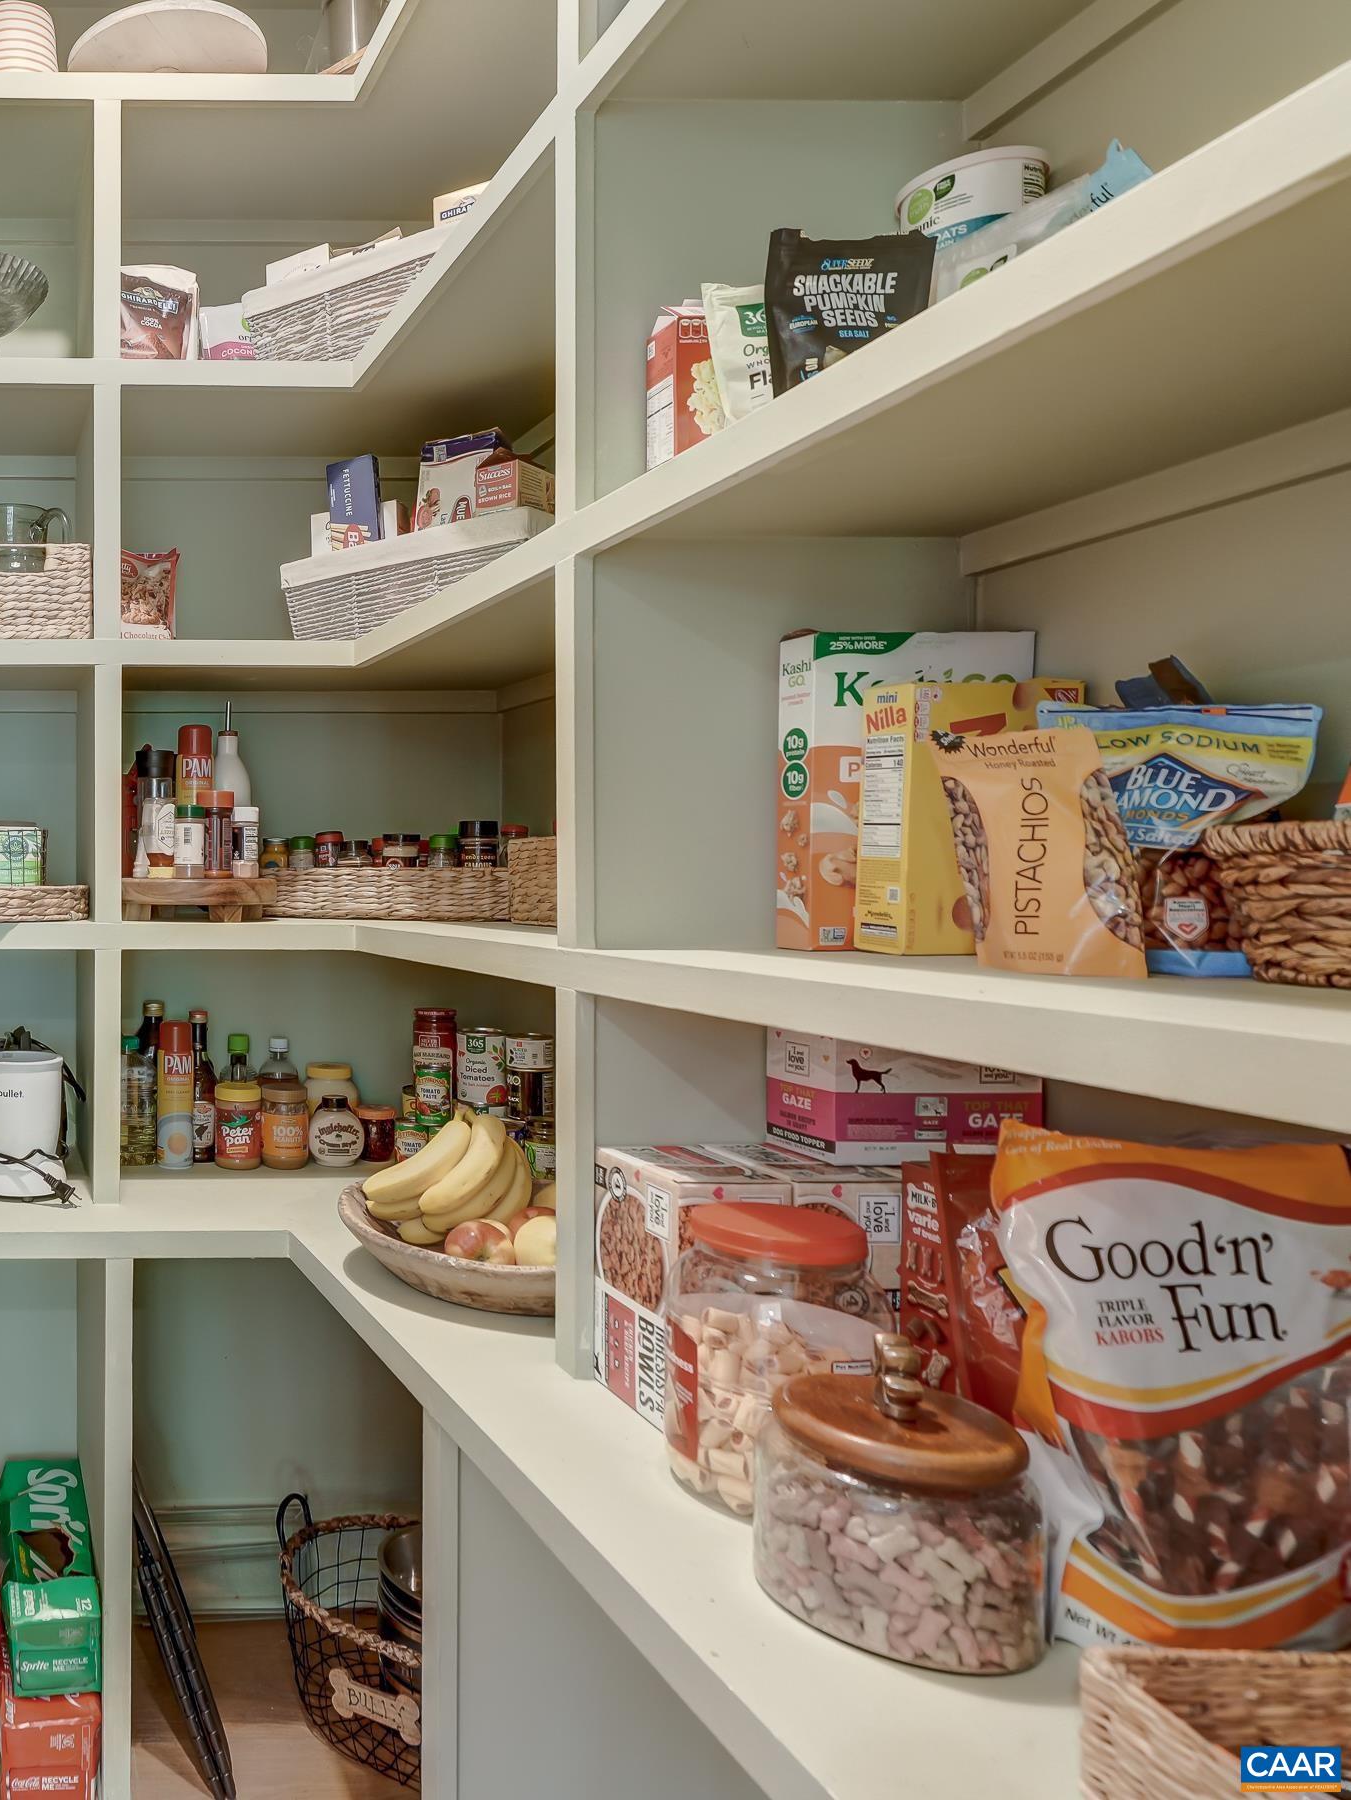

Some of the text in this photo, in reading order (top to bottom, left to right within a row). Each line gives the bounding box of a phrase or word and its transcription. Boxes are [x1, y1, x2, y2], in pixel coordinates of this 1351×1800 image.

[793, 271, 899, 297] SNACKABLE
[803, 293, 887, 313] PUMPKIN
[822, 308, 879, 328] SEEDS
[838, 329, 870, 338] SEA SALT
[478, 467, 512, 482] Success
[829, 640, 854, 651] 25%
[782, 658, 812, 677] Kashi
[877, 691, 898, 704] mini
[865, 706, 908, 735] Nilla
[786, 735, 805, 750] 10g
[966, 736, 1056, 759] Wonderful
[1161, 730, 1261, 755] SODIUM
[181, 758, 212, 778] PAM
[985, 758, 1056, 770] Honey Roasted
[786, 773, 805, 788] 10g
[1126, 764, 1203, 793] BLUE
[1014, 776, 1050, 935] PISTACHIOS
[467, 1038, 484, 1048] 365
[164, 1055, 192, 1074] PAM
[788, 1053, 805, 1065] love
[465, 1065, 488, 1074] Diced
[459, 1073, 495, 1082] Tomatoes
[782, 1095, 812, 1111] GAZE
[220, 1126, 254, 1138] Peter
[272, 1125, 303, 1137] 100%
[772, 1127, 826, 1150] DOG FOOD TOPPER
[873, 1201, 889, 1233] love
[1097, 1298, 1148, 1313] TRIPLE
[1097, 1313, 1155, 1327] FLAVOR
[1159, 1284, 1284, 1353] Fun
[1095, 1327, 1165, 1347] KABOBS
[638, 1314, 655, 1414] BOWLS
[81, 1598, 92, 1611] 12
[1064, 1607, 1092, 1629] Net
[20, 1660, 50, 1673] Sprite
[52, 1657, 89, 1665] RECYCLE
[52, 1665, 65, 1673] ME
[41, 1775, 79, 1784] RECYCLE
[41, 1783, 55, 1791] ME
